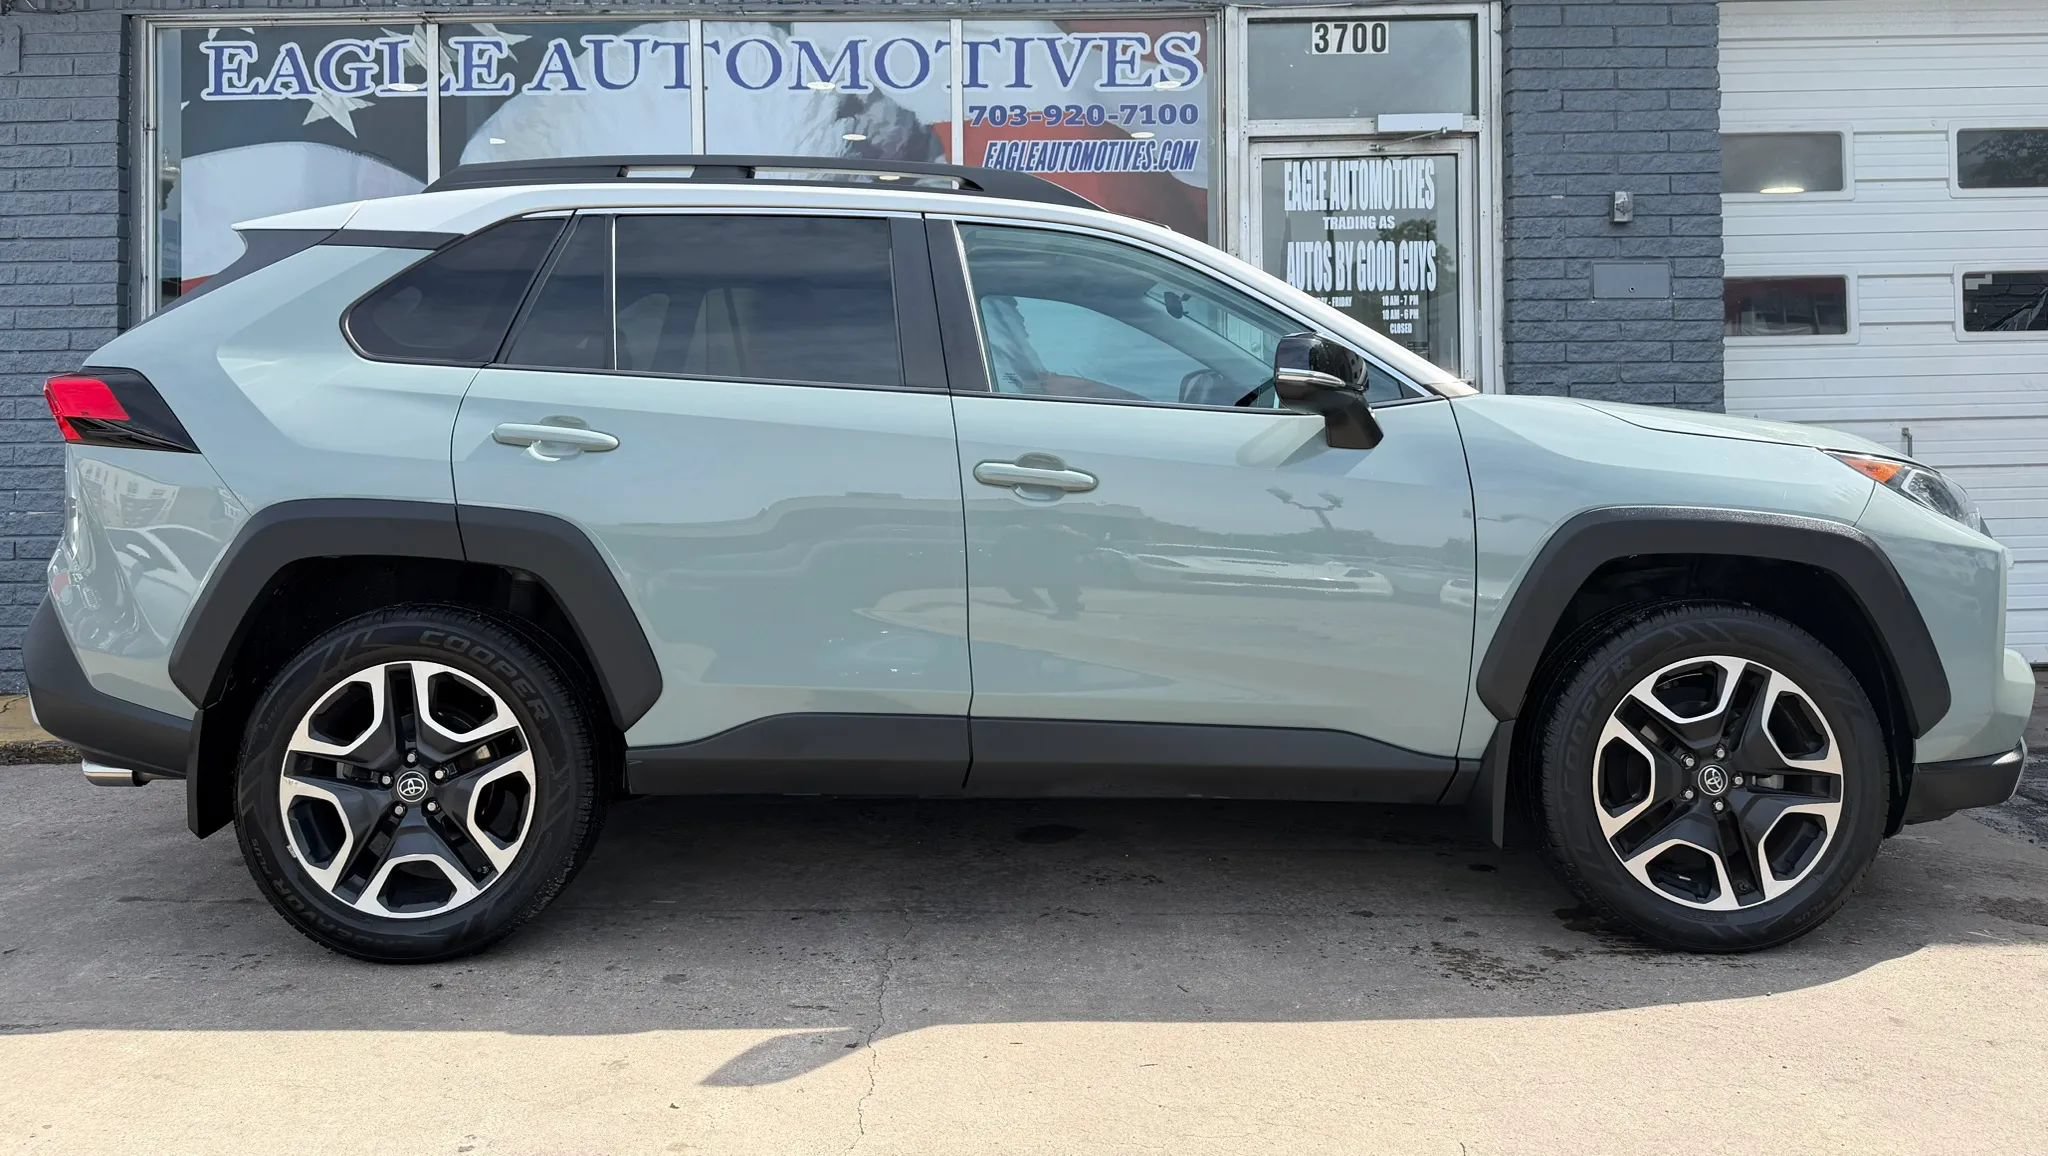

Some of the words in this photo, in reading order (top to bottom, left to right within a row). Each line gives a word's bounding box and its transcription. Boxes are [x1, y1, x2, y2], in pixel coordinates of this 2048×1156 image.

[1313, 22, 1388, 53] 3700
[202, 36, 514, 99] EAGLE
[524, 31, 1204, 95] AUTOMOTIVES
[968, 103, 1200, 127] 703-920-7100
[983, 138, 1200, 173] EAGLEAUTOMOTIVES.COM
[1284, 160, 1327, 212] EAGLE
[1329, 158, 1435, 211] AUTOMOTIVES
[1322, 215, 1377, 230] TRADING
[1378, 215, 1396, 230] AS
[1286, 240, 1333, 292] AUTOS
[1335, 241, 1354, 291] BY
[1356, 240, 1396, 292] GOOD
[1399, 239, 1437, 292] GUYS
[1331, 296, 1353, 307] FRIDAY
[1390, 295, 1400, 306] AM
[1403, 295, 1408, 306] 7
[1409, 294, 1419, 306] PM
[1390, 309, 1400, 320] AM
[1409, 308, 1419, 320] PM
[1389, 323, 1413, 334] CLOSED
[419, 630, 550, 720] COOPER
